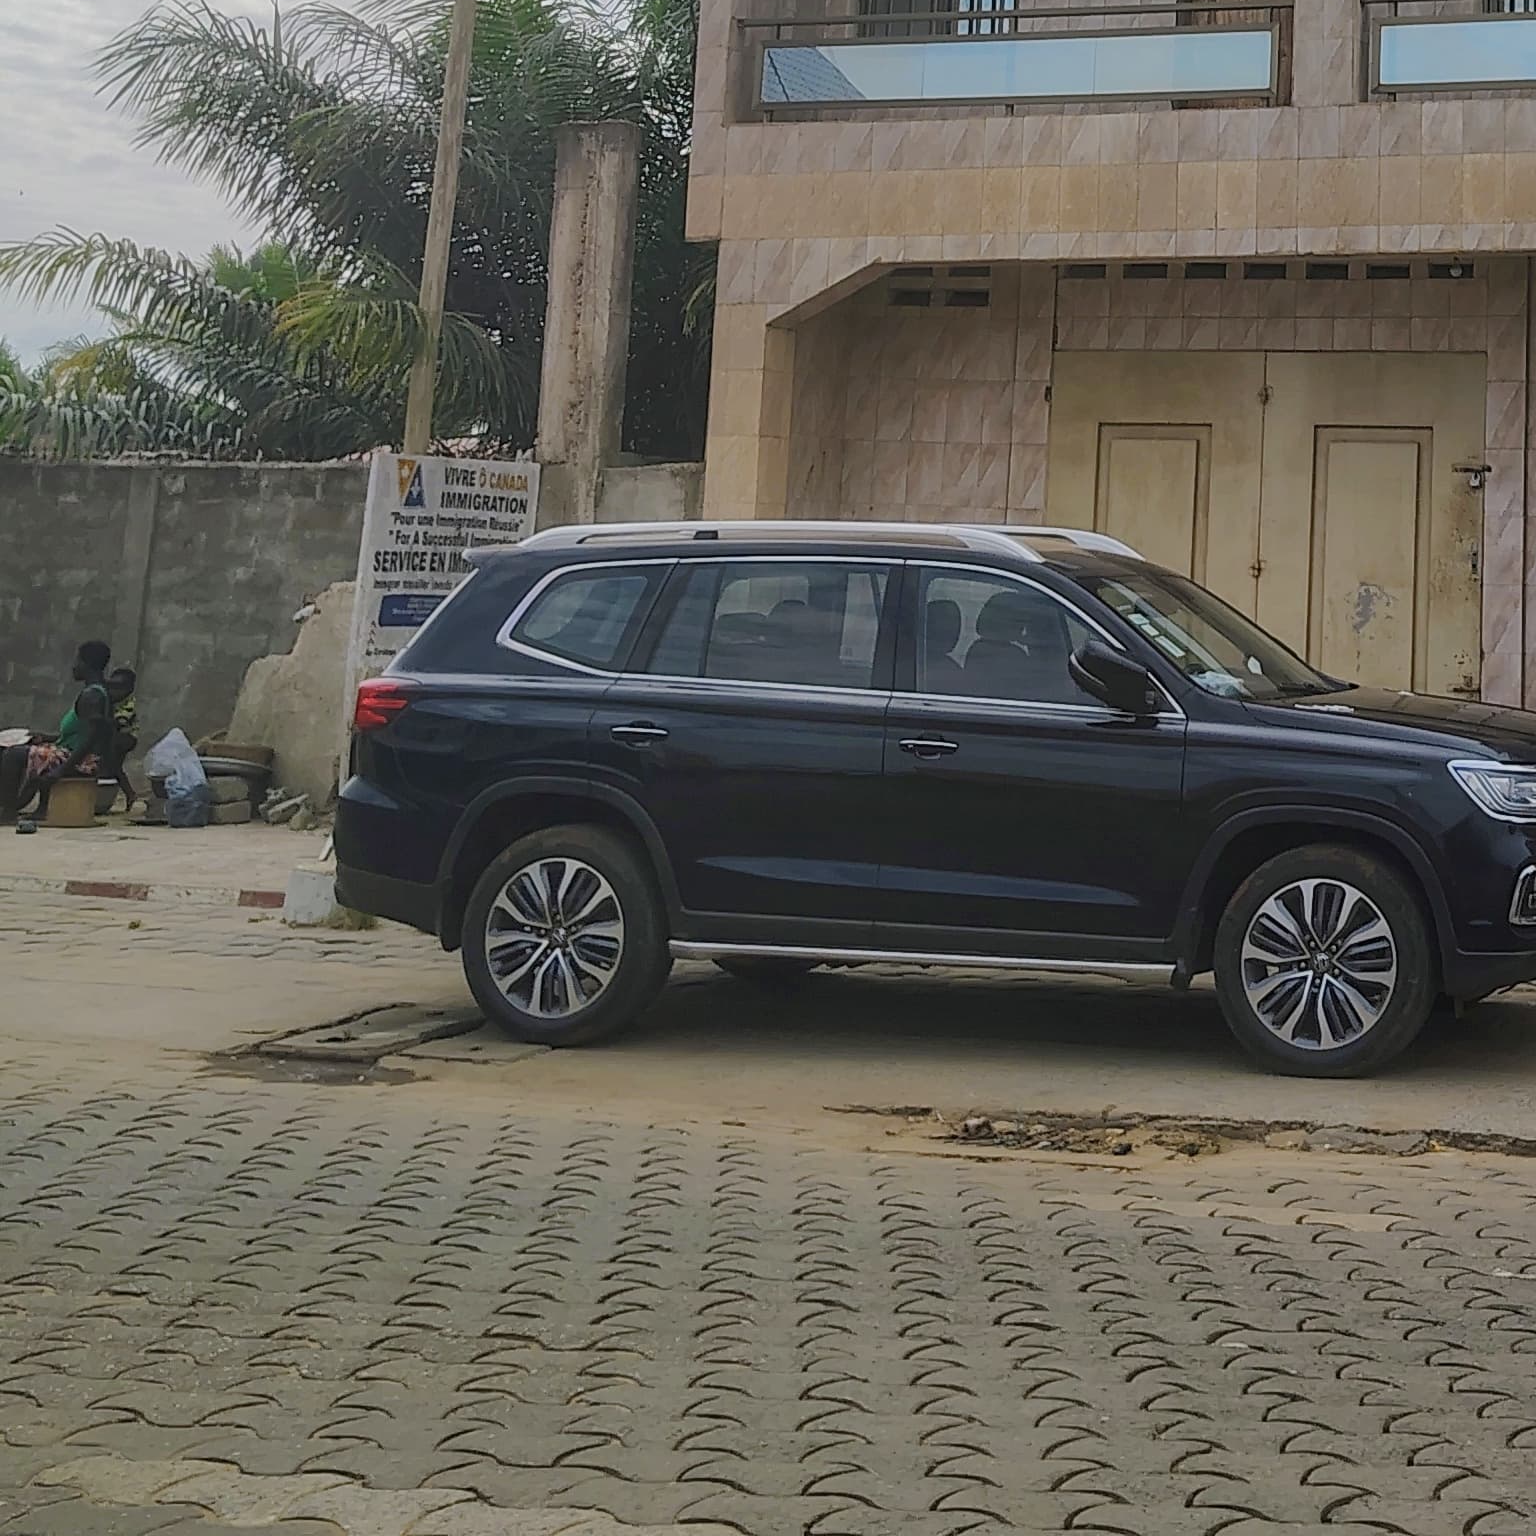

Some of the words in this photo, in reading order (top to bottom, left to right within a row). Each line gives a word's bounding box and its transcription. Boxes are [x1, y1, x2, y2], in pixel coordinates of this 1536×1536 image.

[444, 466, 477, 486] VIVRE
[489, 472, 529, 492] CANADA
[440, 492, 529, 514] IMMIGRATION
[436, 513, 488, 530] Immigration
[411, 530, 420, 545] A
[422, 530, 468, 547] Successful
[373, 550, 428, 573] SERVICE
[429, 551, 446, 573] EN
